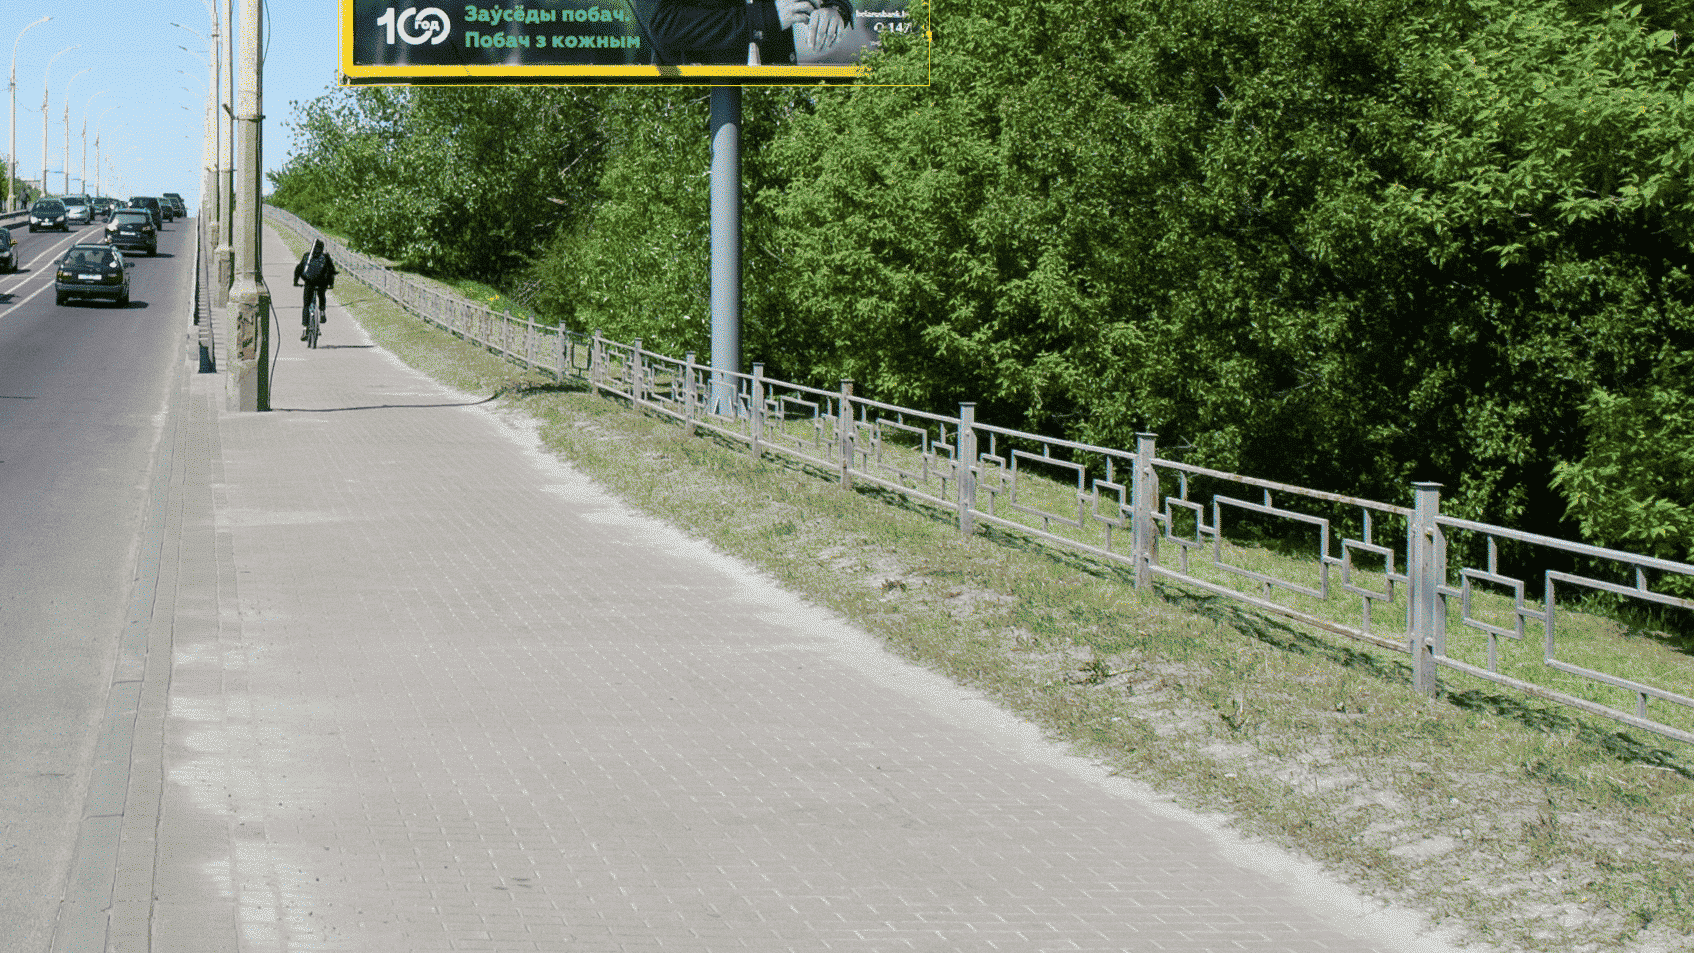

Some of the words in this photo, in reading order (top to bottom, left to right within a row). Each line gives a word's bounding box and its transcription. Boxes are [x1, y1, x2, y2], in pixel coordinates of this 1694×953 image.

[562, 5, 630, 23] побач.
[376, 6, 451, 45] 100
[464, 31, 531, 48] Побач
[535, 35, 547, 48] з
[551, 35, 641, 48] кожным
